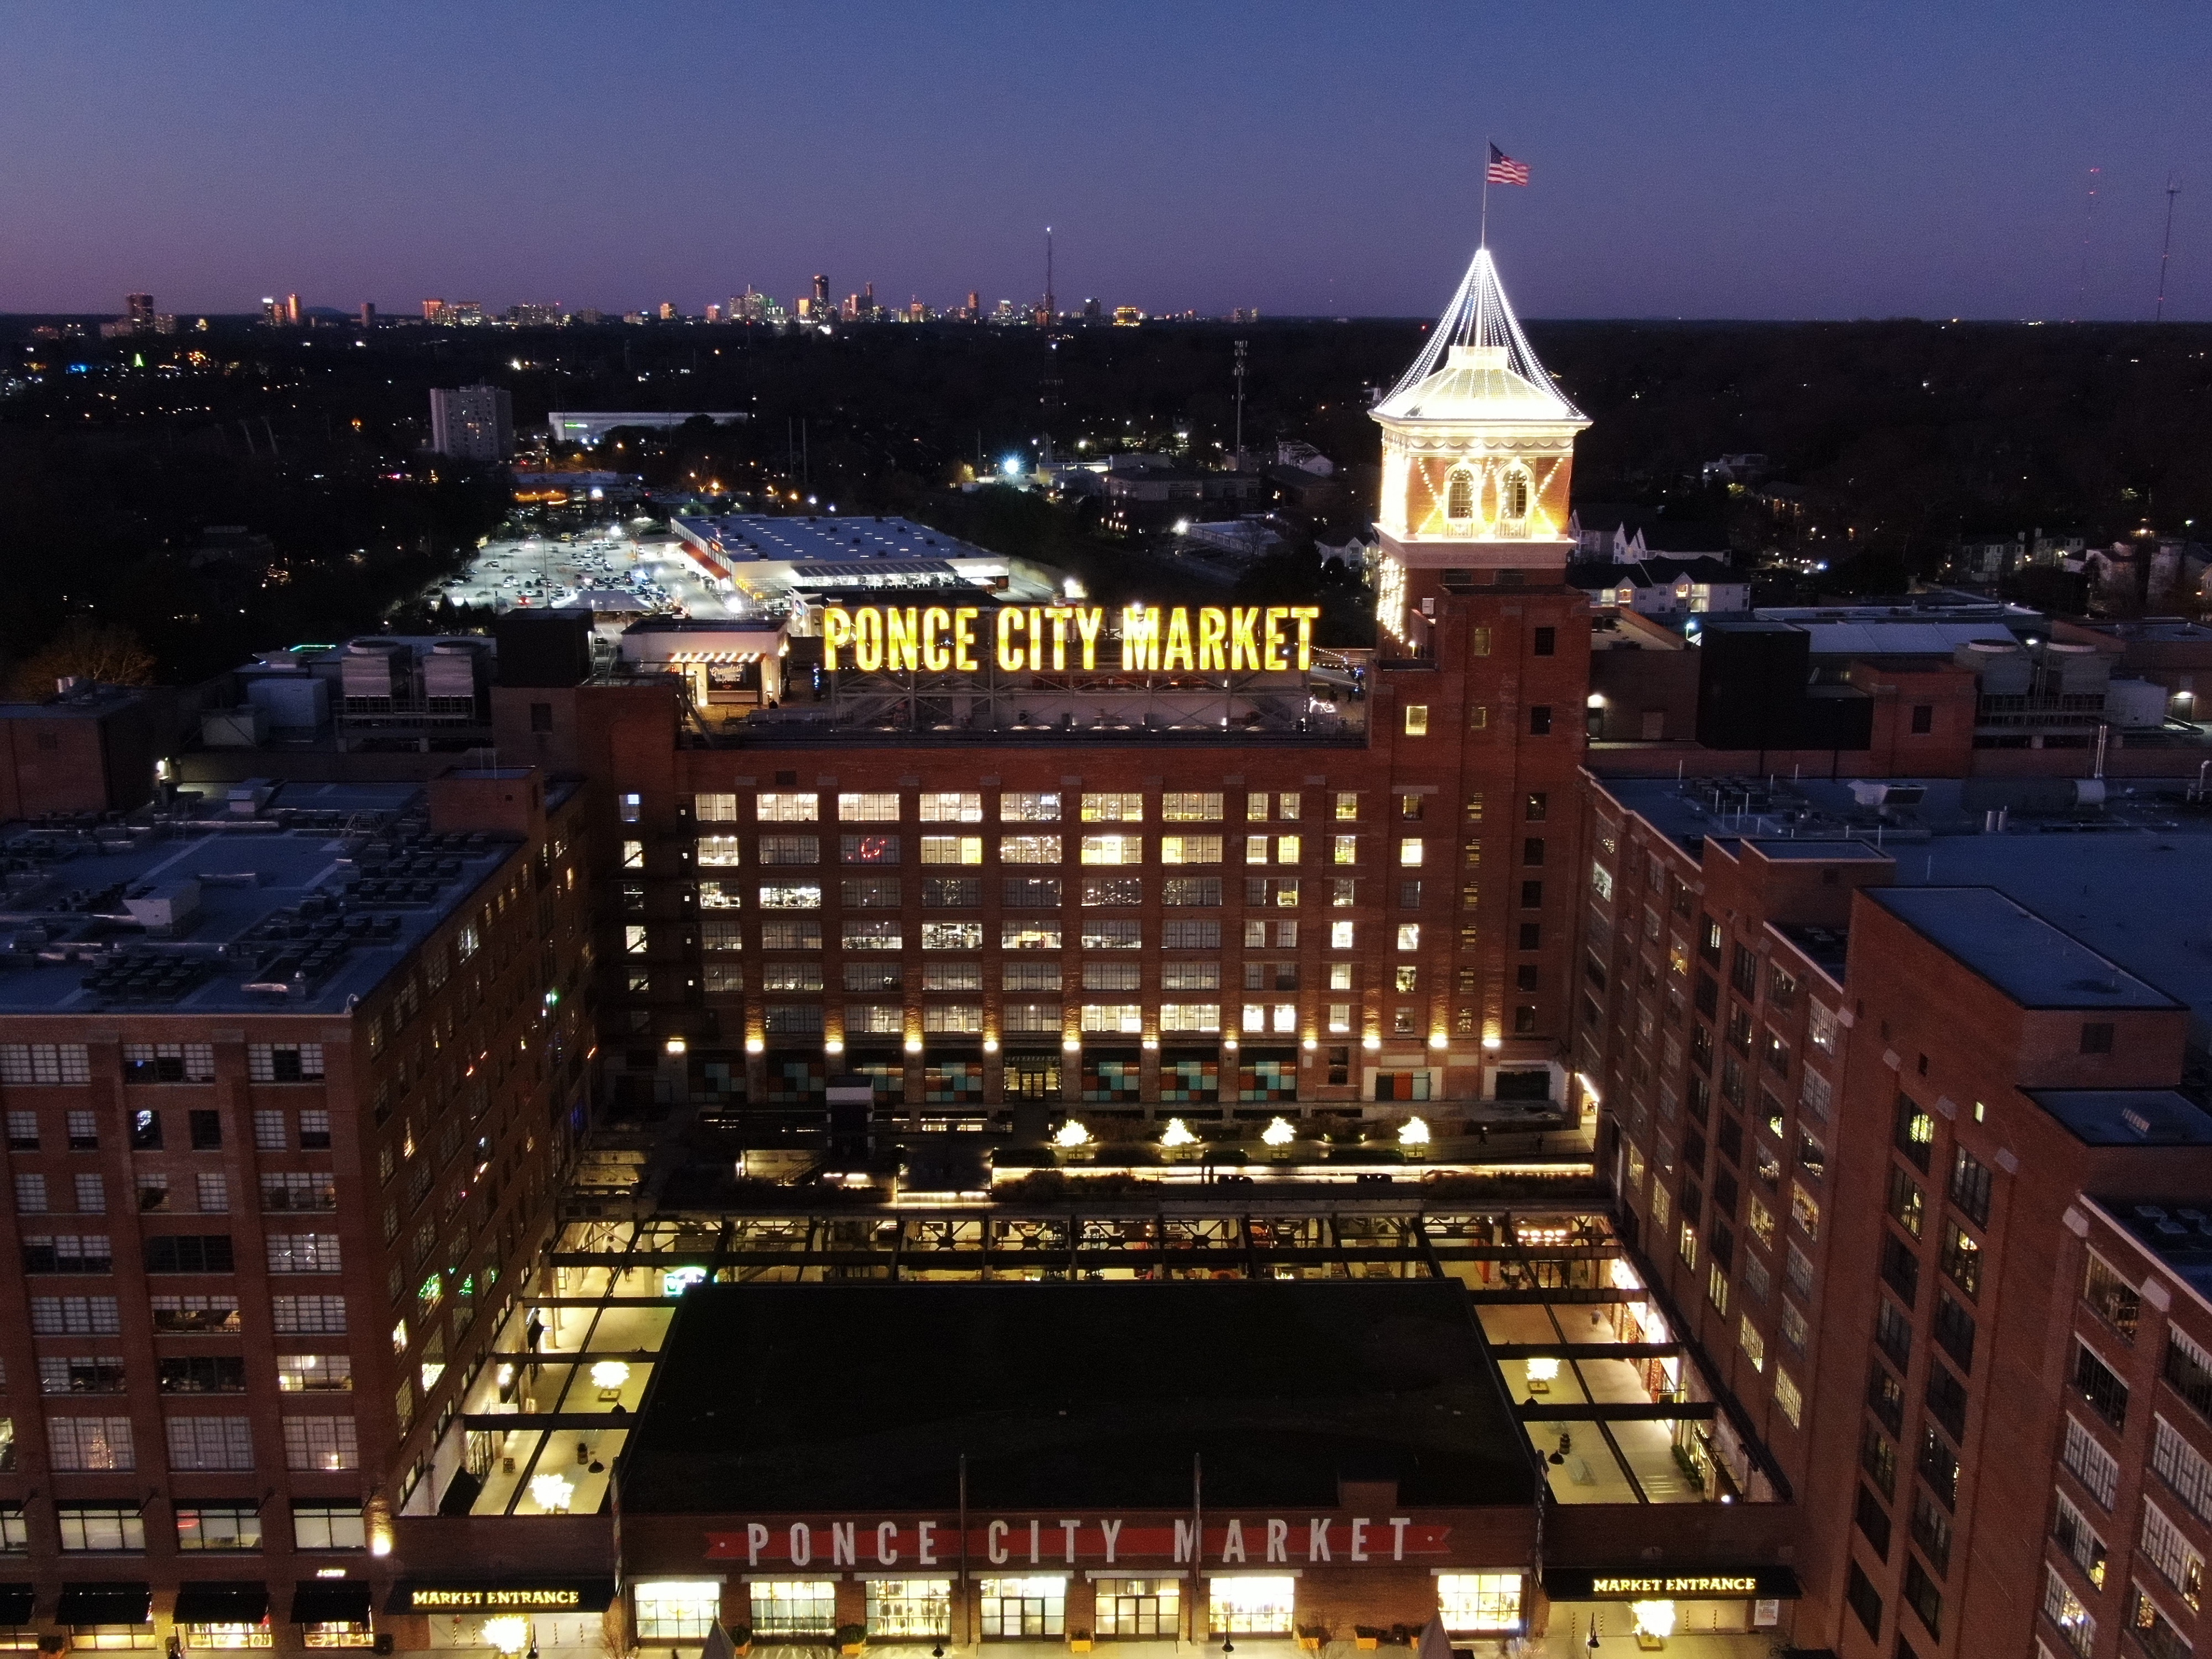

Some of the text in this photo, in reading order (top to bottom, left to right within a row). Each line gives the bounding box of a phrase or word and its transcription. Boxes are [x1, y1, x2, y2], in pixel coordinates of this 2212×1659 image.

[824, 607, 1319, 671] PONCE CITY MARKET
[709, 664, 744, 677] Grandest
[748, 1518, 1411, 1566] PONCE CITY MARKET
[1593, 1578, 1756, 1592] MARKET ENTRANCE
[413, 1591, 579, 1605] MARKET ENTRANCE
